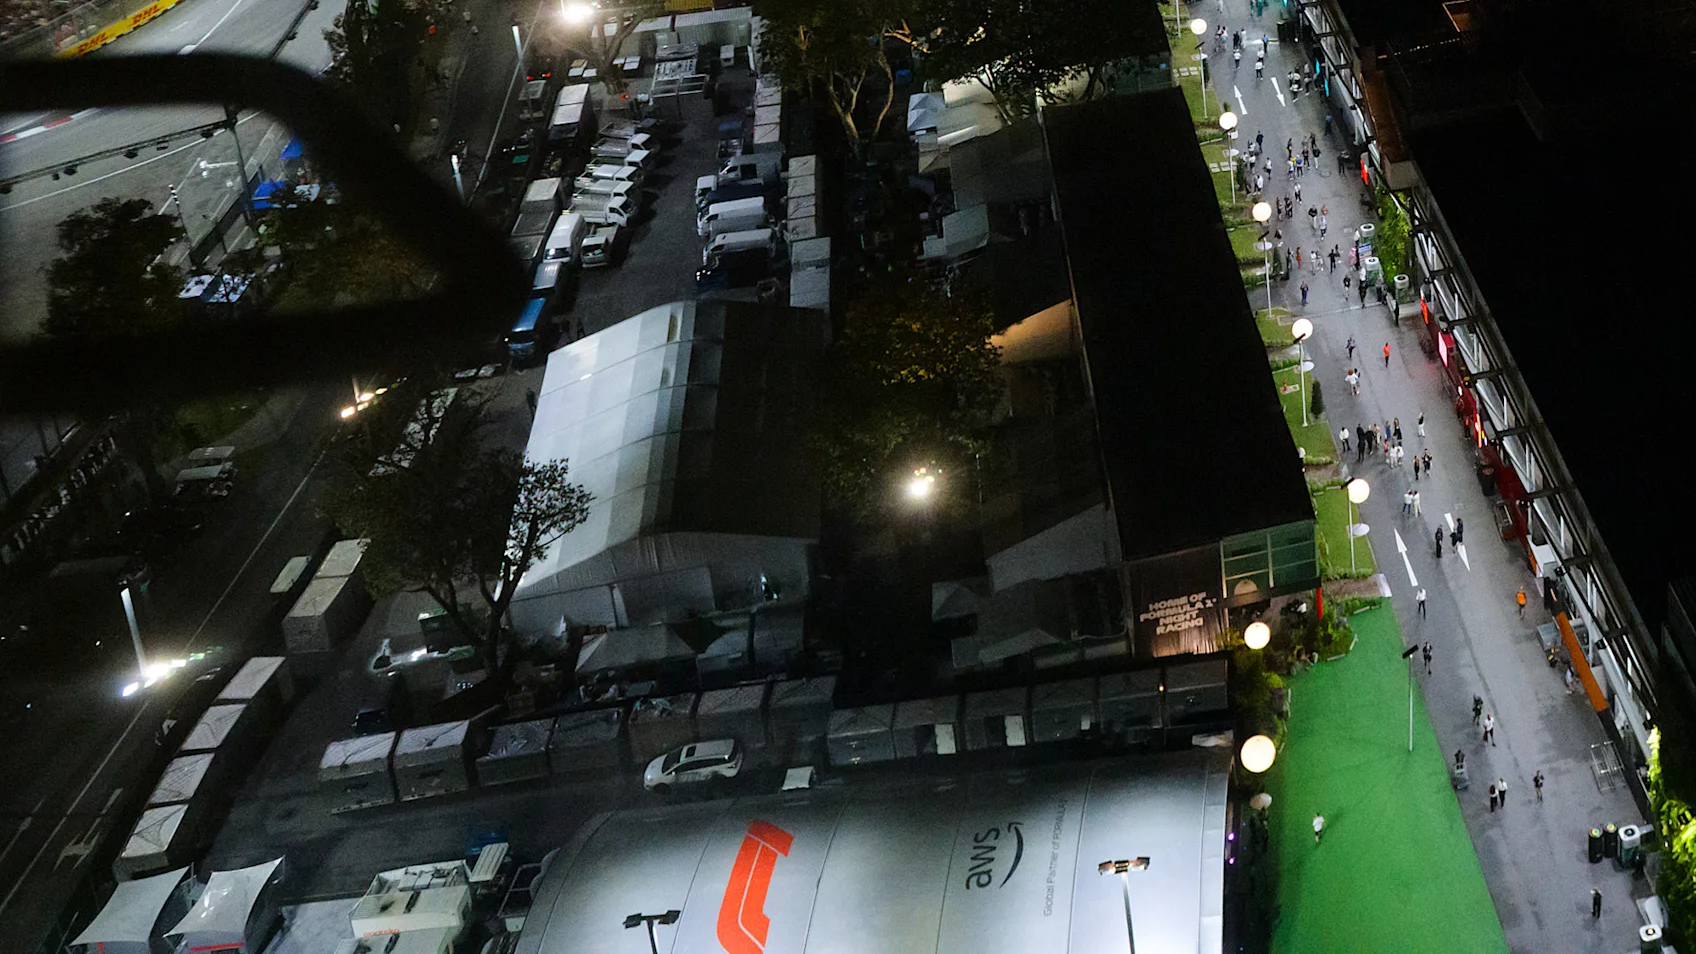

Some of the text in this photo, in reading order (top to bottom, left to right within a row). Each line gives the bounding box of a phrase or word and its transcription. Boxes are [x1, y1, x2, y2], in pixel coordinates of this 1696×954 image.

[132, 4, 161, 25] DHL
[77, 32, 109, 55] DHL
[1149, 591, 1207, 612] HOME OF
[1139, 602, 1204, 623] FORMULA
[1159, 610, 1199, 625] NIGHT
[1156, 617, 1204, 636] RACING
[965, 826, 1001, 889] aws
[1043, 886, 1055, 917] Global
